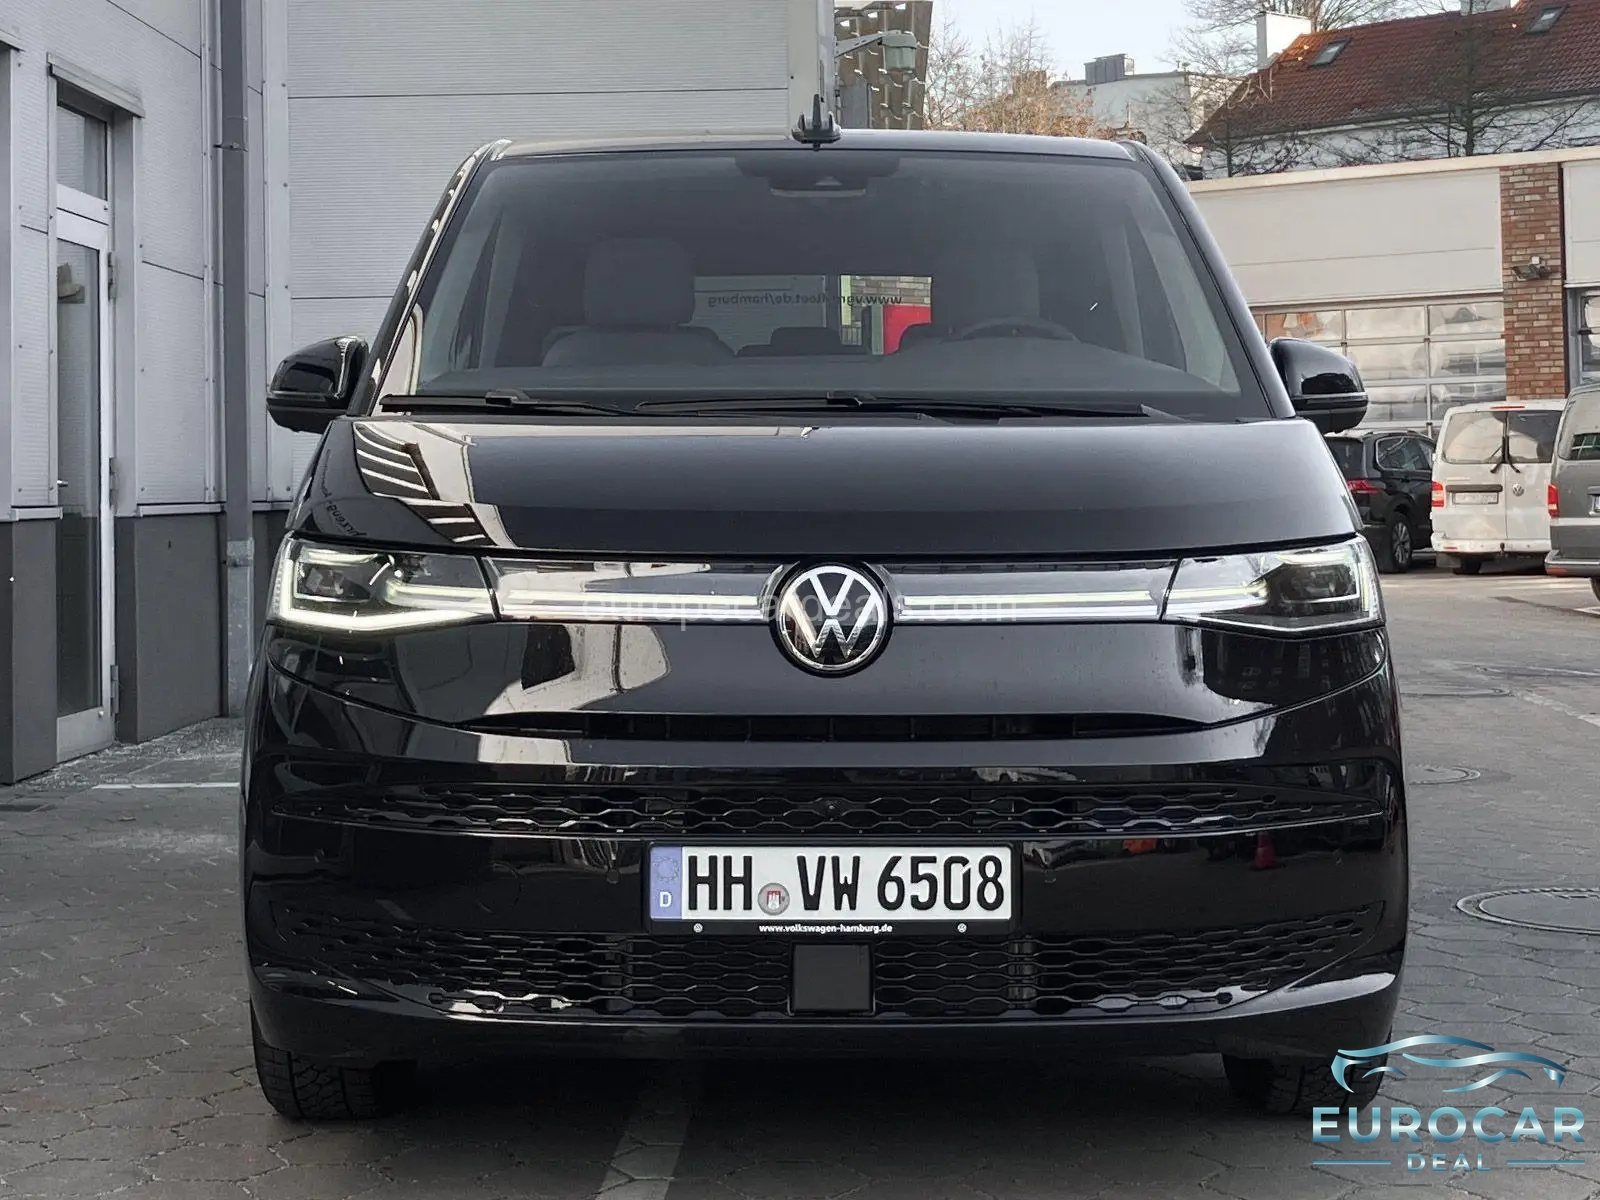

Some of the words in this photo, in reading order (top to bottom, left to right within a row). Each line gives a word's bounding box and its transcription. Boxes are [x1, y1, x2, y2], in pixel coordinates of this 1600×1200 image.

[783, 570, 881, 662] VW
[659, 891, 672, 907] D
[688, 855, 752, 911] HH
[797, 855, 860, 911] VW
[877, 855, 1004, 911] 6508
[759, 923, 893, 935] www.volkswagen-hamburg.de
